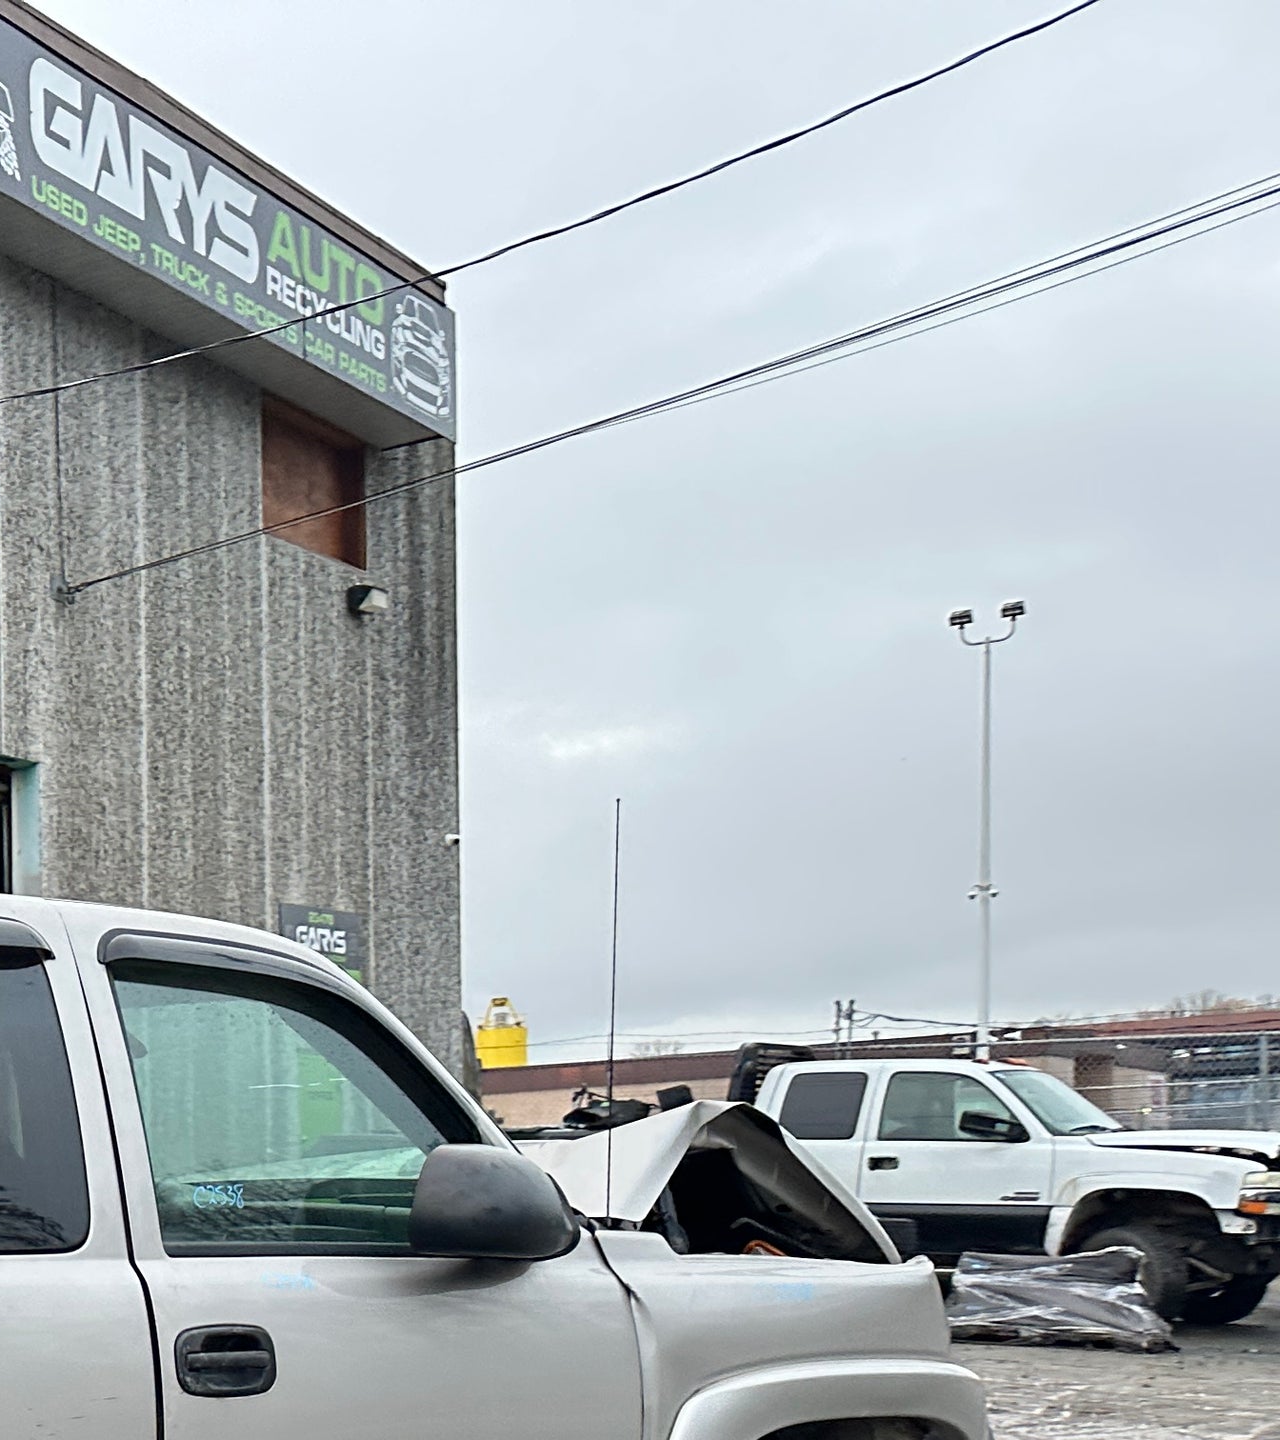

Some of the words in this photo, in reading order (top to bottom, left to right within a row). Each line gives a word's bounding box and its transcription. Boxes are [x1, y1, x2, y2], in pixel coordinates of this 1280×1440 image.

[30, 57, 260, 284] GARYS
[31, 175, 88, 227] USED
[150, 242, 210, 296] TRUCK
[215, 281, 228, 306] &
[233, 292, 298, 345] SPORTS
[304, 331, 336, 366] CAR
[339, 352, 387, 392] PARTS
[266, 265, 386, 360] RECYCLING
[267, 210, 384, 326] AUTO
[193, 1184, 245, 1208] C2538
